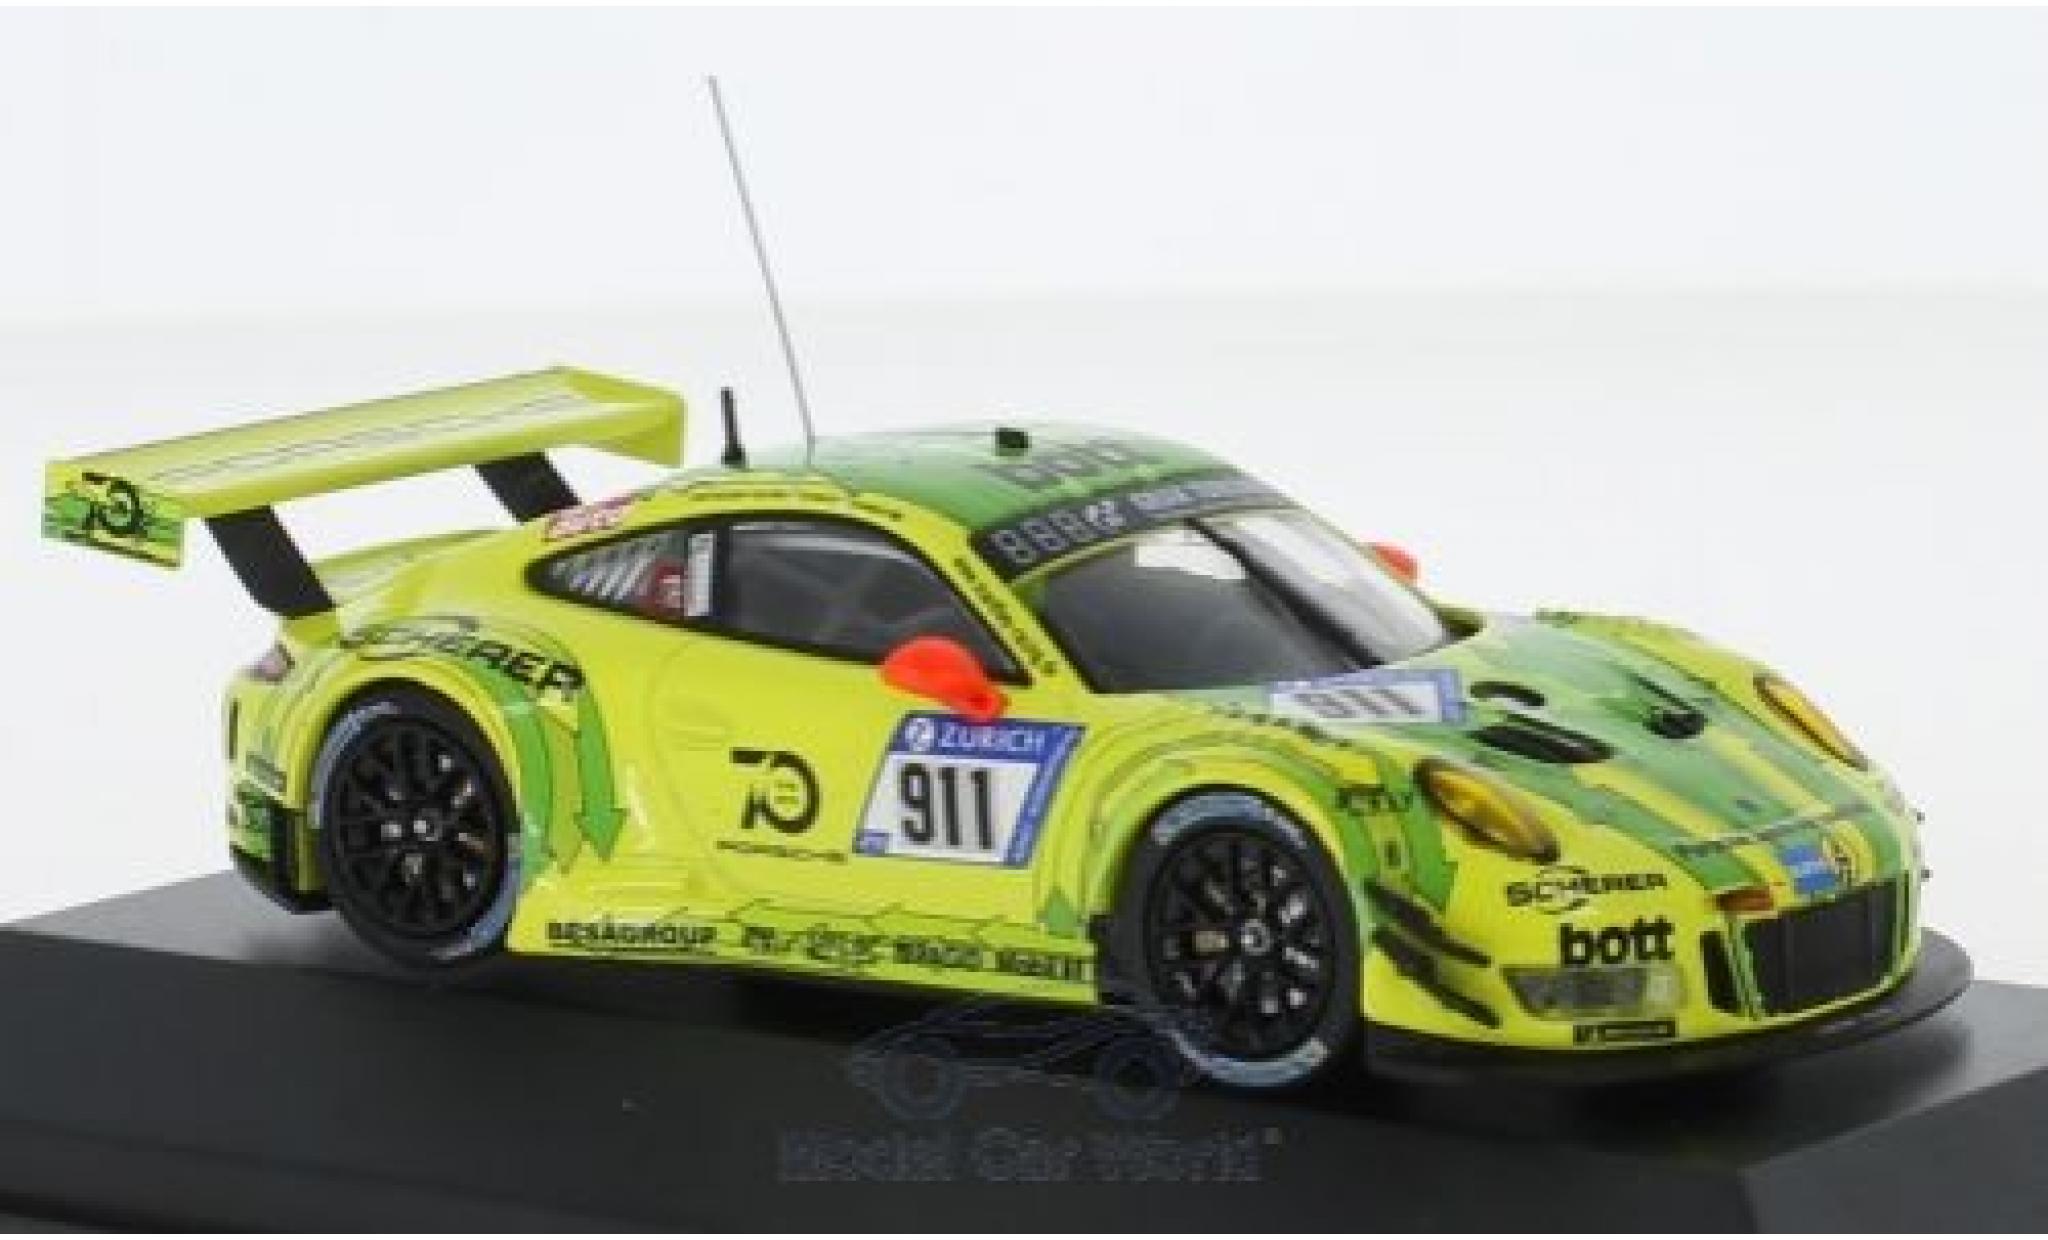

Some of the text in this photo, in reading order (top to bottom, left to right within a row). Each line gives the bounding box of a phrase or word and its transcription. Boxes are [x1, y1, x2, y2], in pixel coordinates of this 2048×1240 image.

[1294, 688, 1426, 719] 911
[937, 722, 1046, 752] ZURICH
[900, 762, 993, 851] 911
[1507, 872, 1669, 907] SCHERER
[1560, 916, 1676, 964] bott
